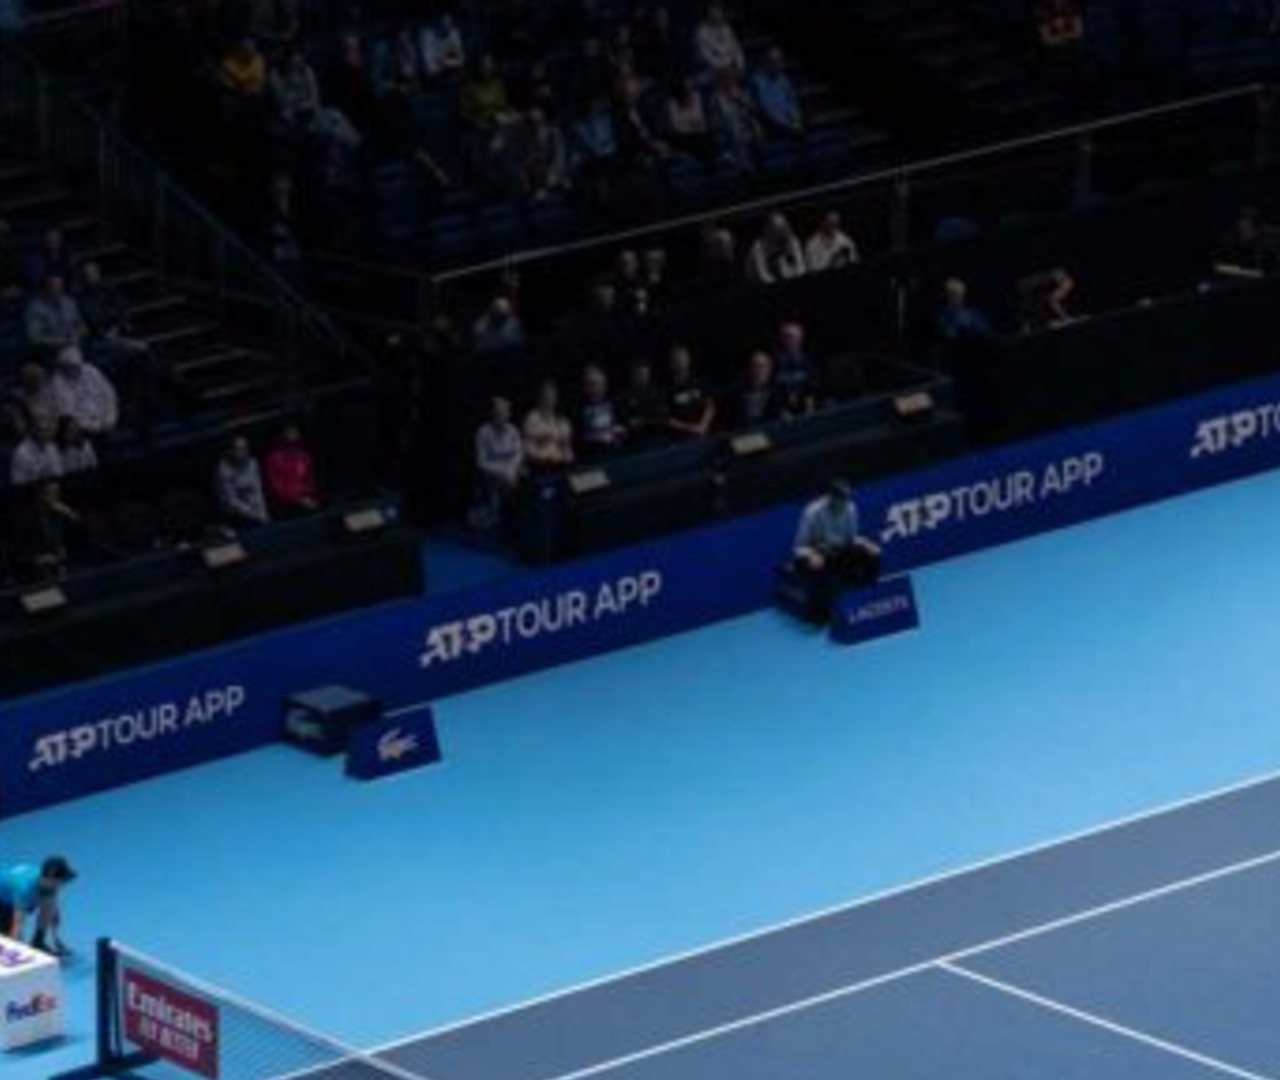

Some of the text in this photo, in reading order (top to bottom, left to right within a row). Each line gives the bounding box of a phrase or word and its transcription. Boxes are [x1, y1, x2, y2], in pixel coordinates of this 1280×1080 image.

[1040, 452, 1103, 498] APP
[594, 570, 661, 620] APP
[183, 684, 245, 729] APP
[5, 992, 58, 1022] FedEx
[126, 981, 213, 1044] Emirates
